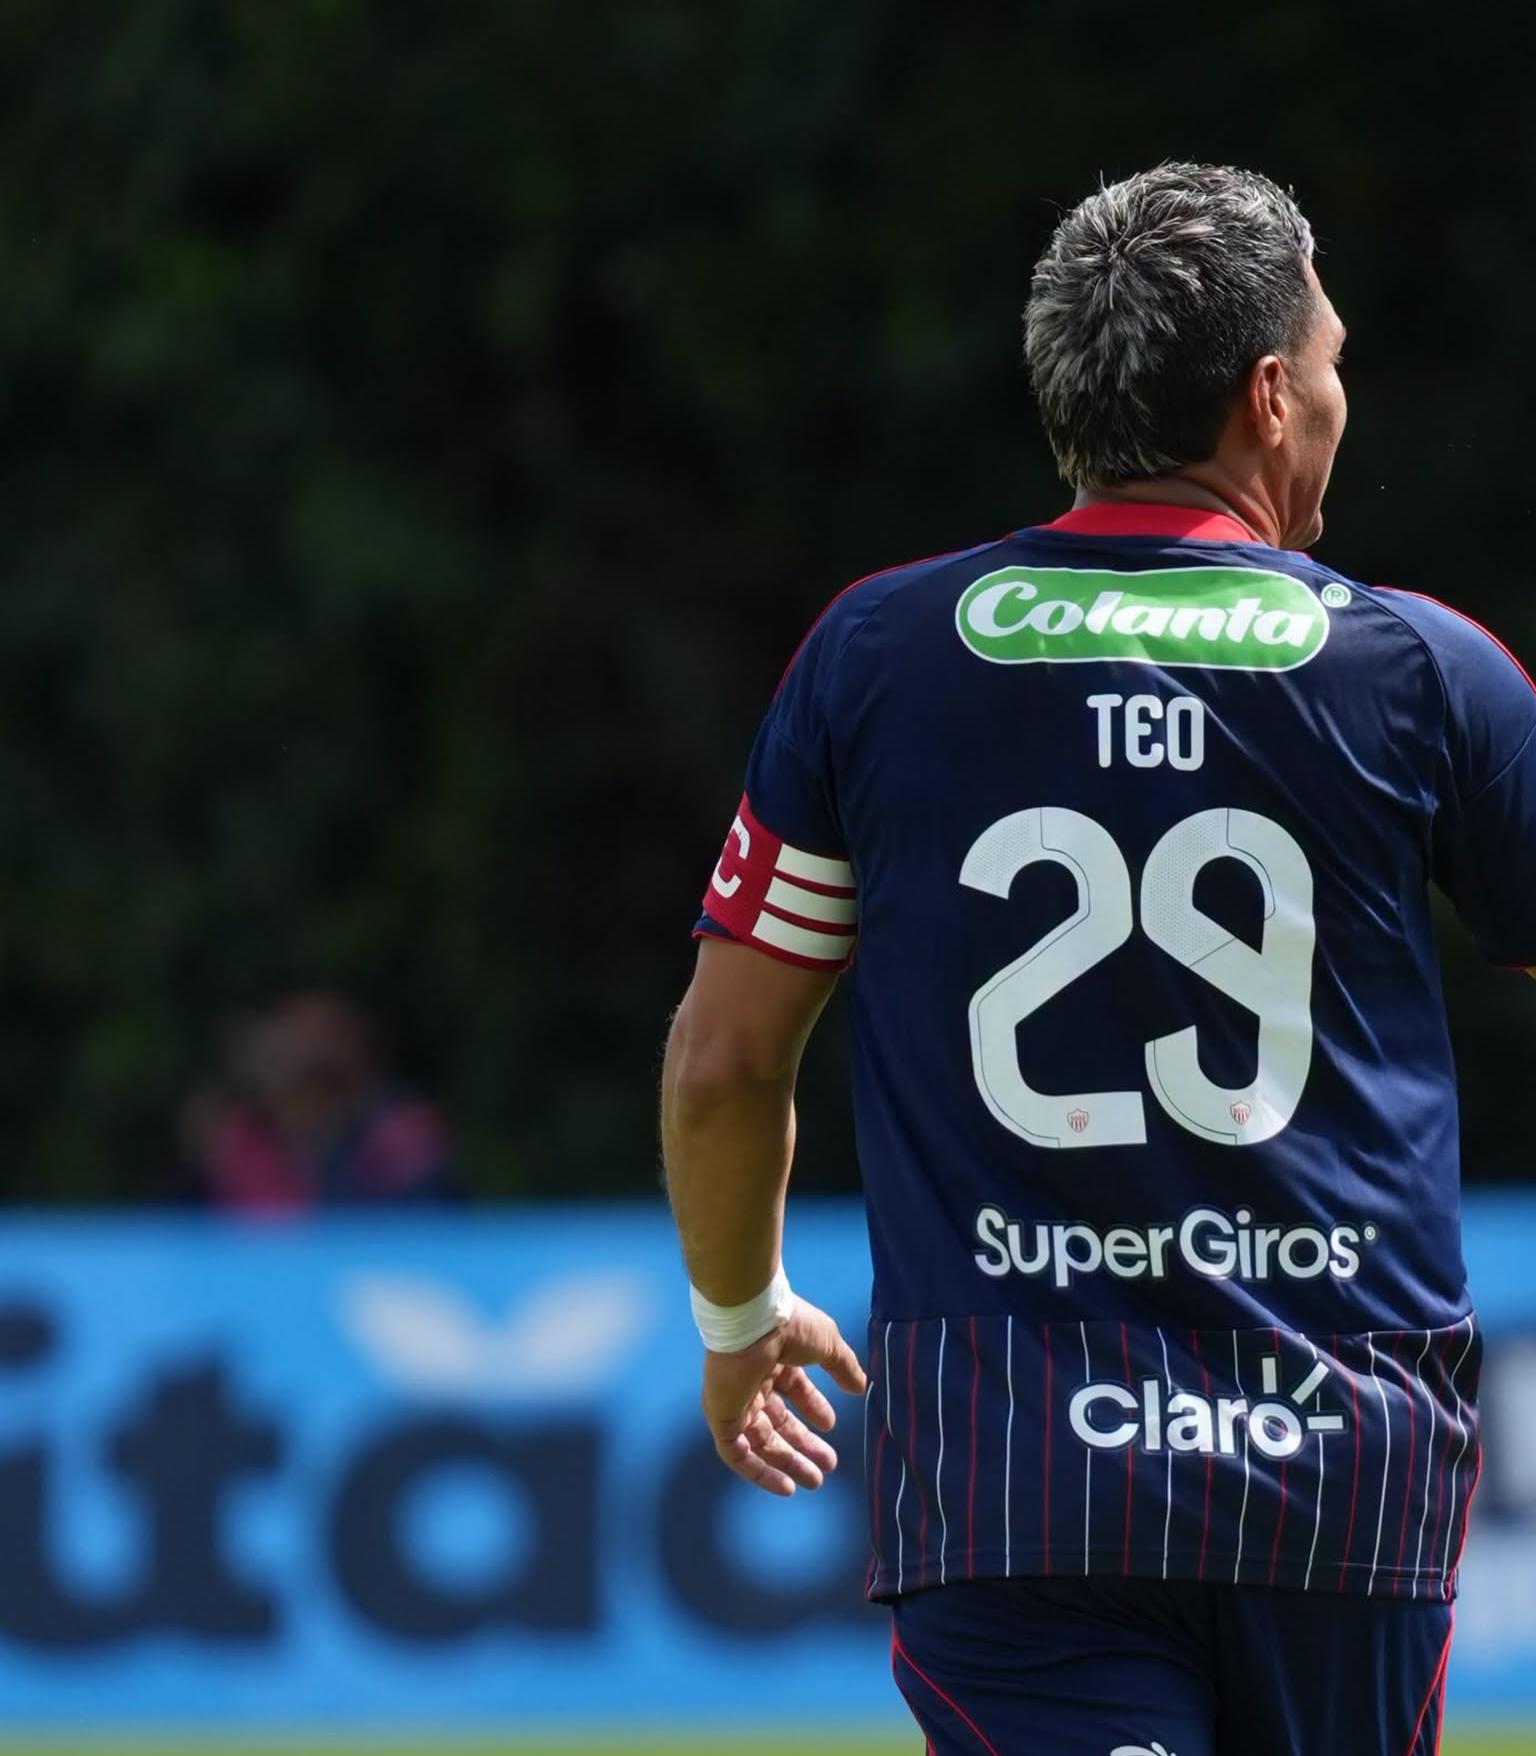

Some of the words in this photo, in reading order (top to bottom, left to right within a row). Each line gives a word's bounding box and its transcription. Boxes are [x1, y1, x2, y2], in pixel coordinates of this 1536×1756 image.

[967, 580, 1313, 648] Colanta
[1087, 694, 1205, 771] TEO
[711, 815, 750, 898] C
[959, 807, 1315, 1148] 29
[1069, 1379, 1302, 1457] Claro
